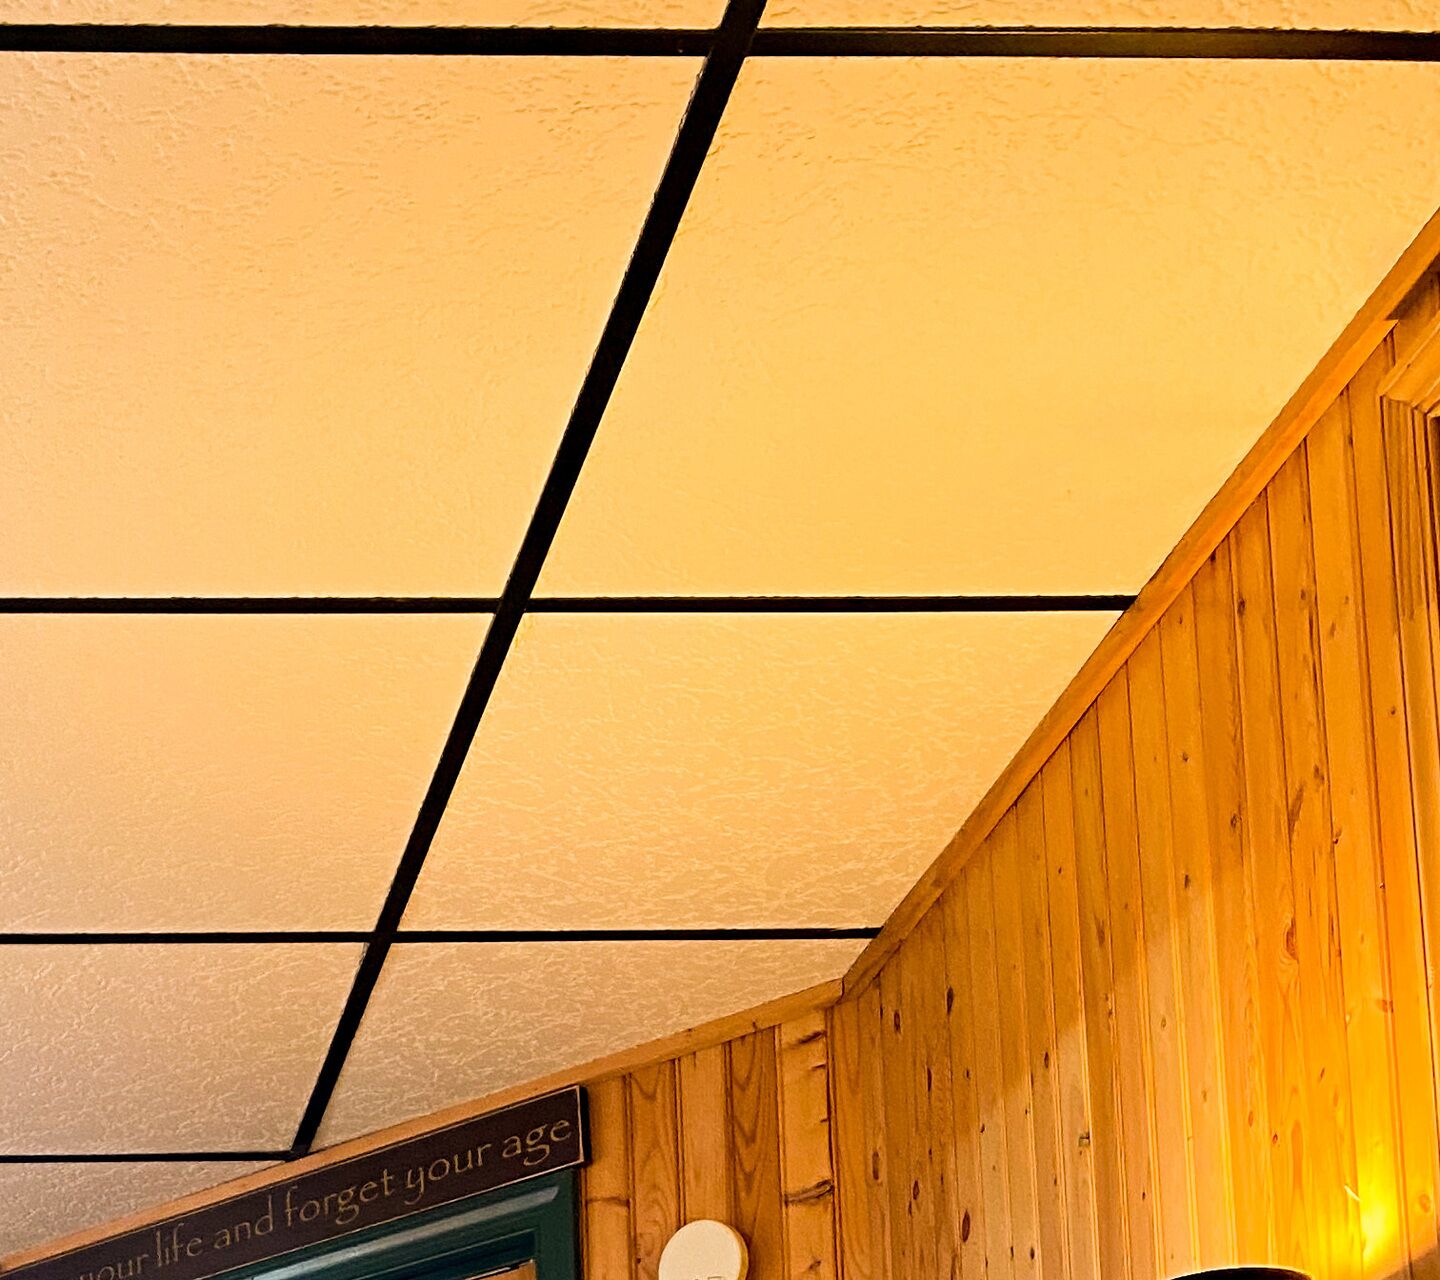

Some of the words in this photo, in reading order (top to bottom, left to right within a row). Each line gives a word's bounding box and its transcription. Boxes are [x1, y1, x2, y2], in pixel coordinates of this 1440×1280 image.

[155, 1222, 204, 1268] life
[213, 1194, 273, 1249] and
[285, 1167, 394, 1226] forget
[403, 1142, 493, 1205] your
[501, 1118, 571, 1167] age
